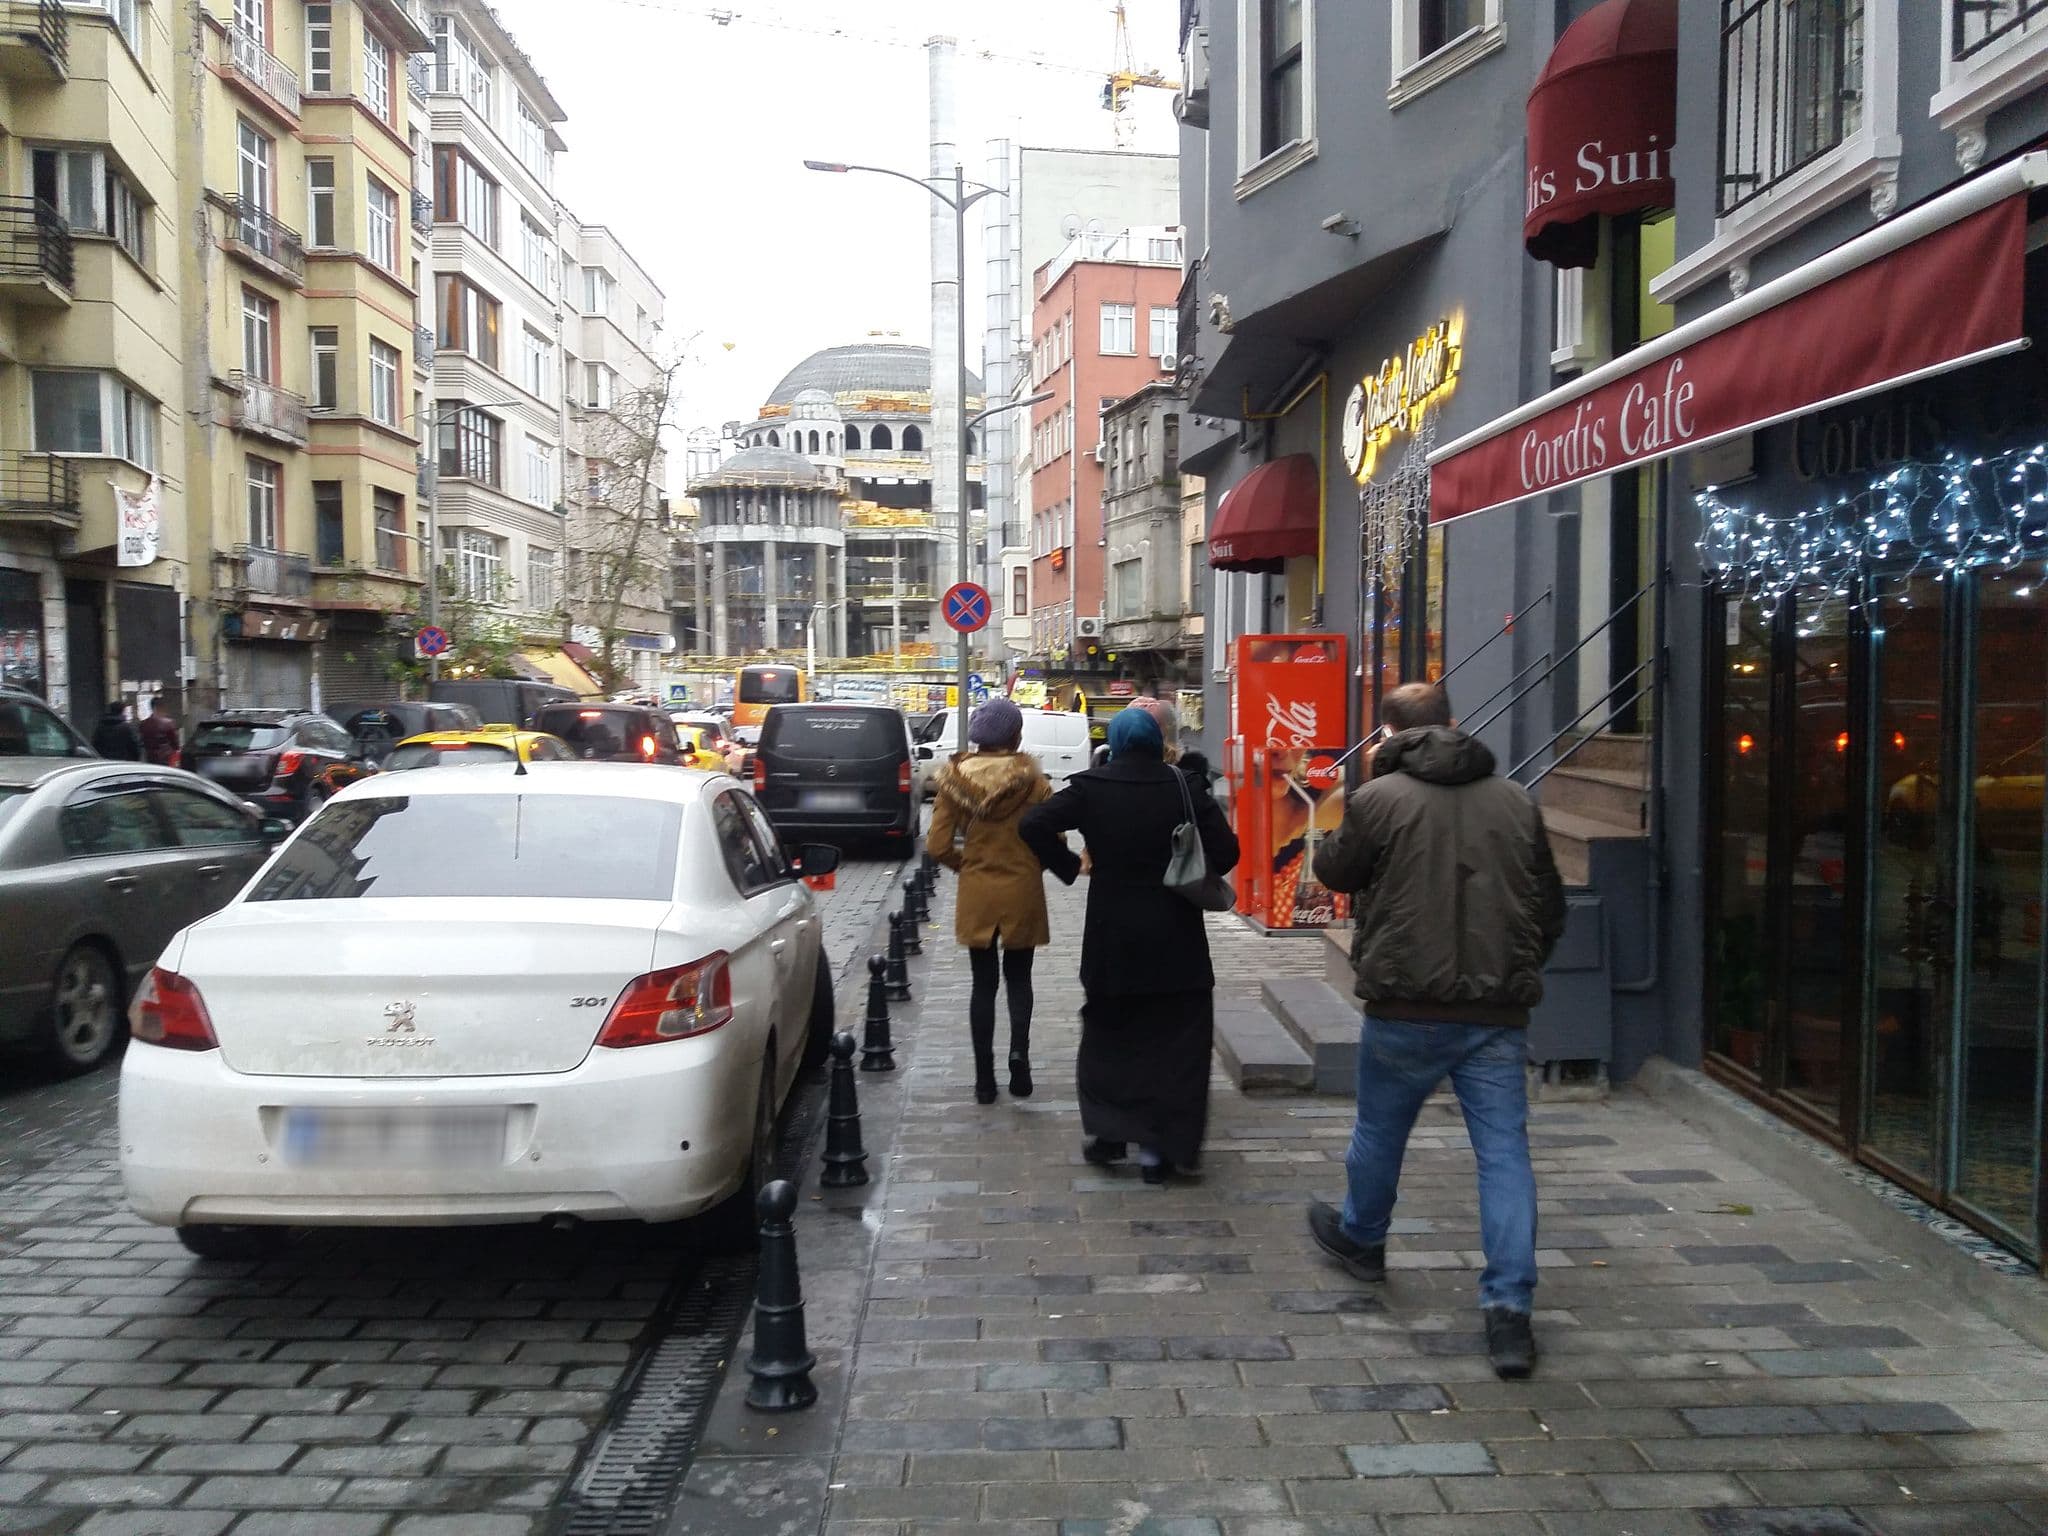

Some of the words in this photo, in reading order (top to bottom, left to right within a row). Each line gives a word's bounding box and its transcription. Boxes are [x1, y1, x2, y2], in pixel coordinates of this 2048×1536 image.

[1520, 401, 1606, 490] Cordis
[1619, 357, 1696, 456] Cafe
[569, 996, 608, 1009] 301
[367, 1037, 437, 1048] PEUGEOT
